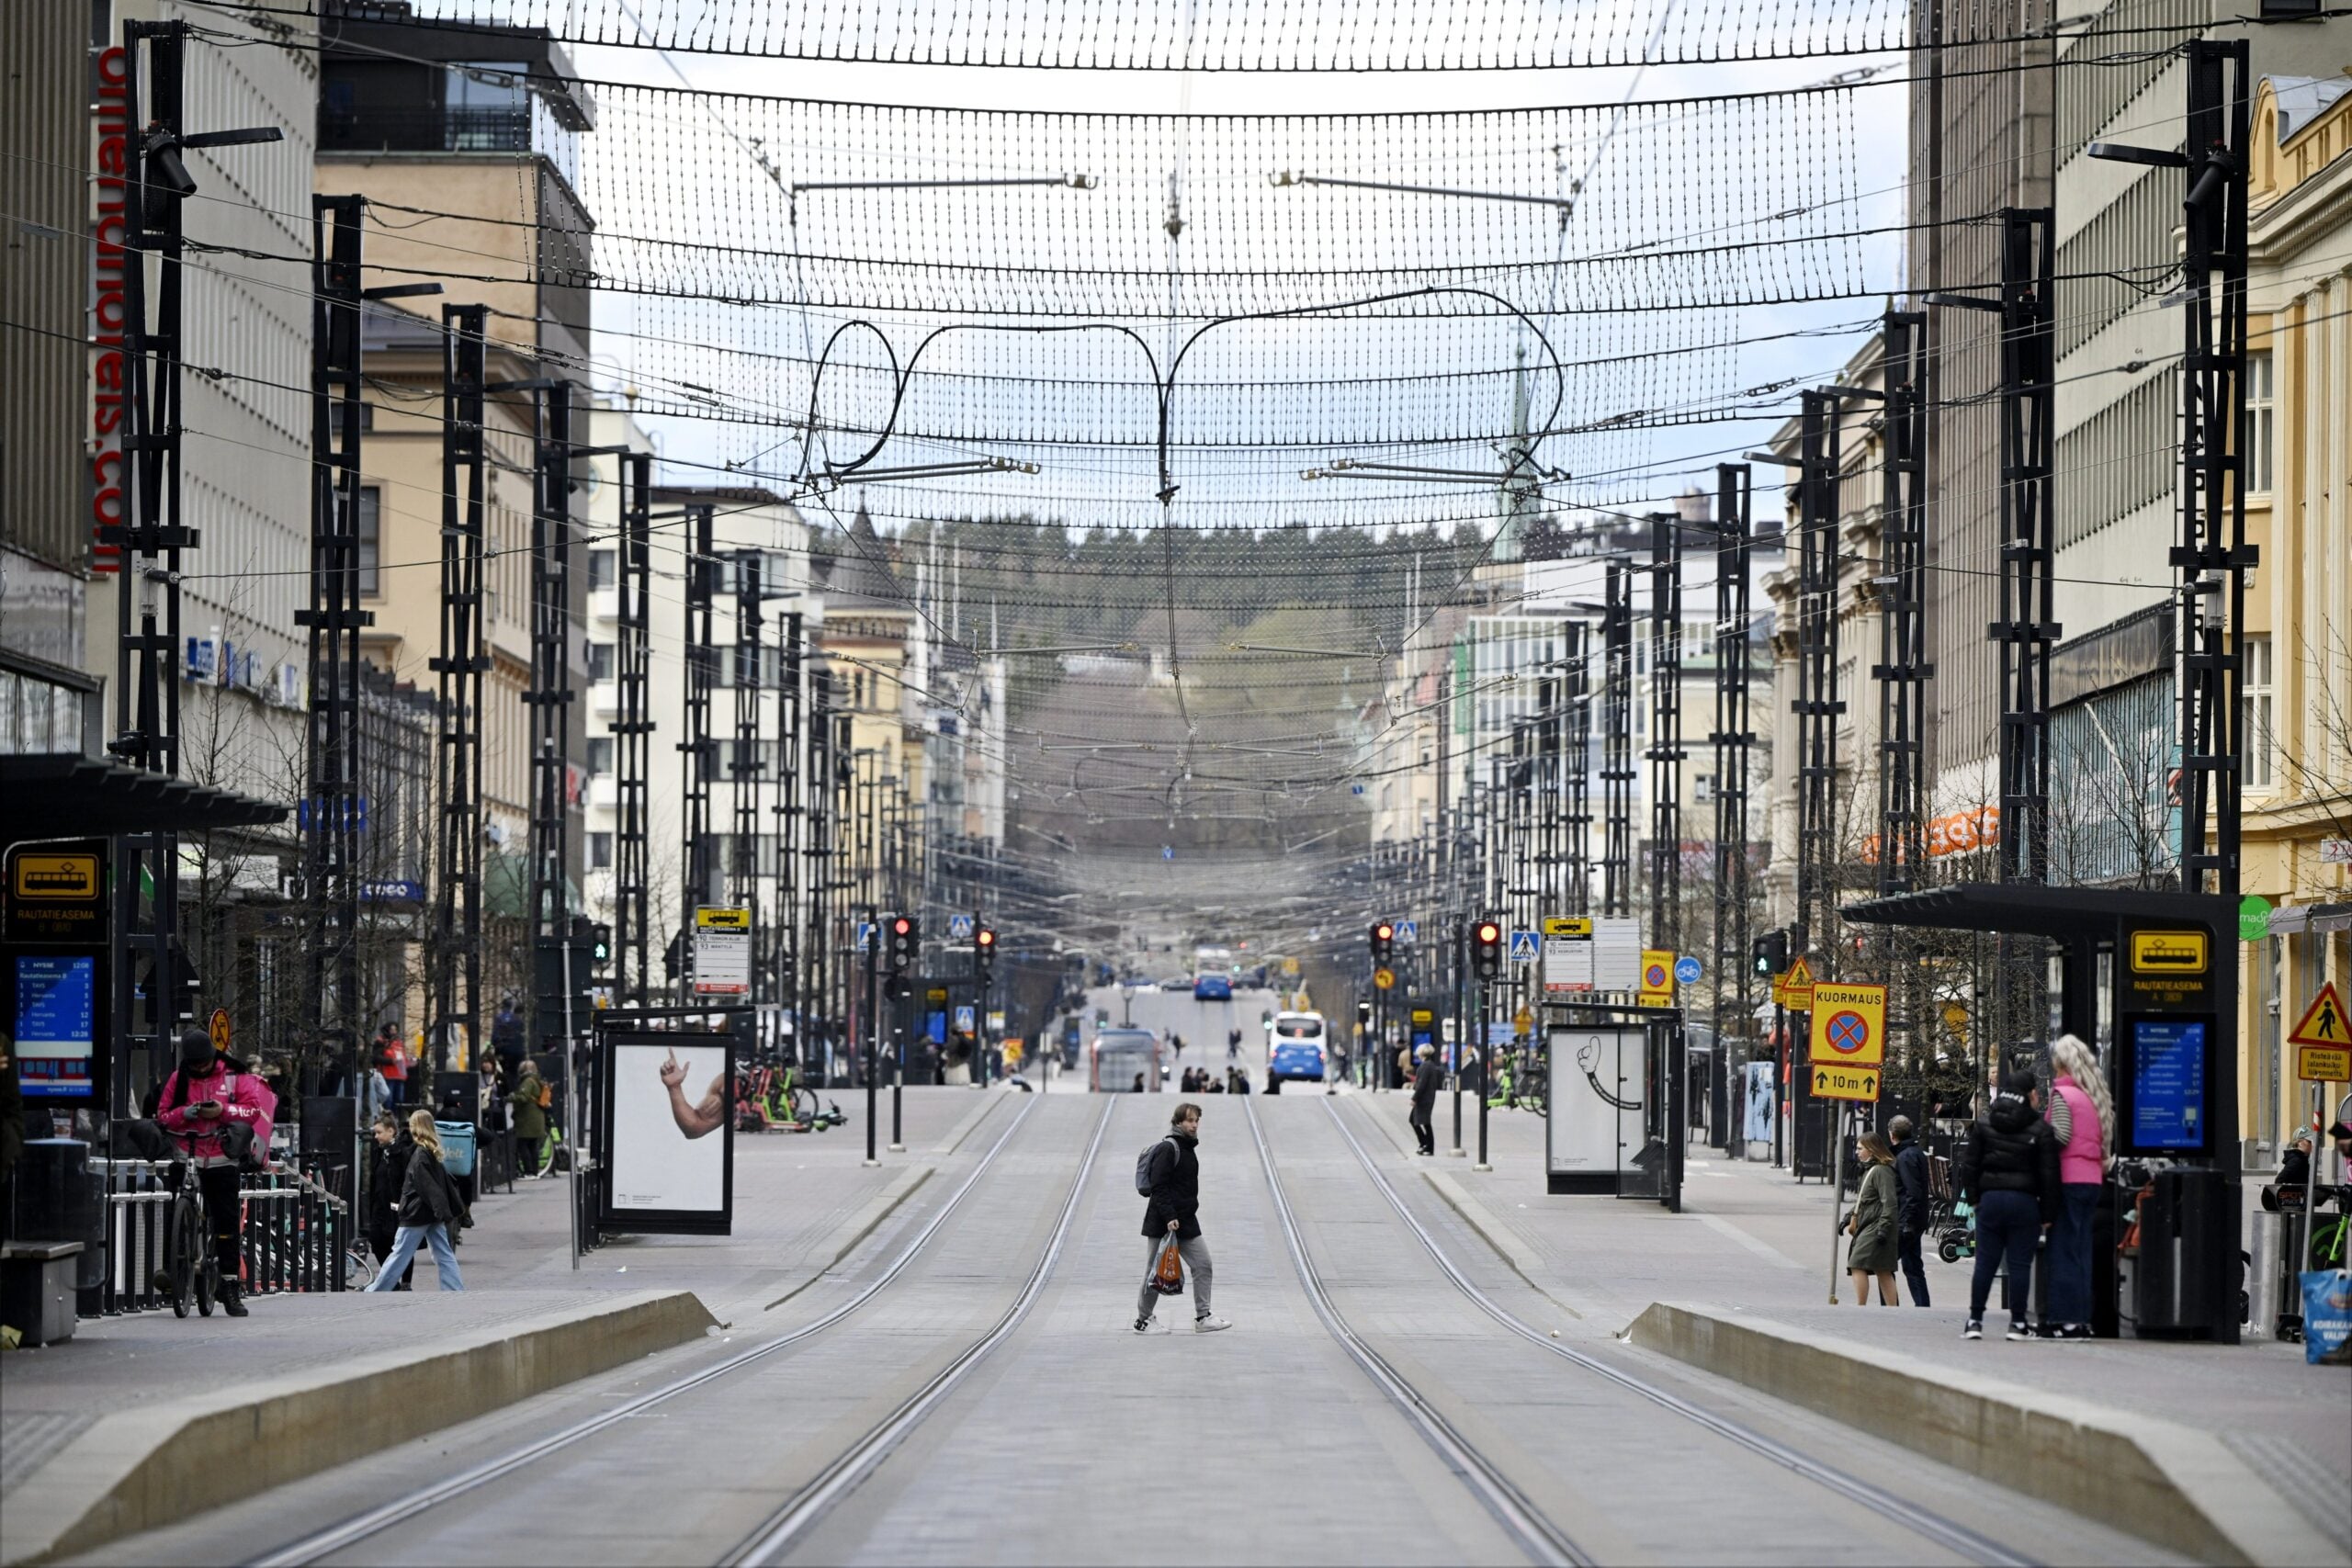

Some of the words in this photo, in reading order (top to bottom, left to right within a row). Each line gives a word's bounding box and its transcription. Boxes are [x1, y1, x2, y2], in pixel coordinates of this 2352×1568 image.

[17, 909, 96, 919] RAUTATIEASEMA
[2133, 981, 2204, 991] RAUTATIEASEMA
[1816, 992, 1882, 1005] KUORMAUS
[1833, 1076, 1845, 1088] 10
[1848, 1078, 1859, 1089] m
